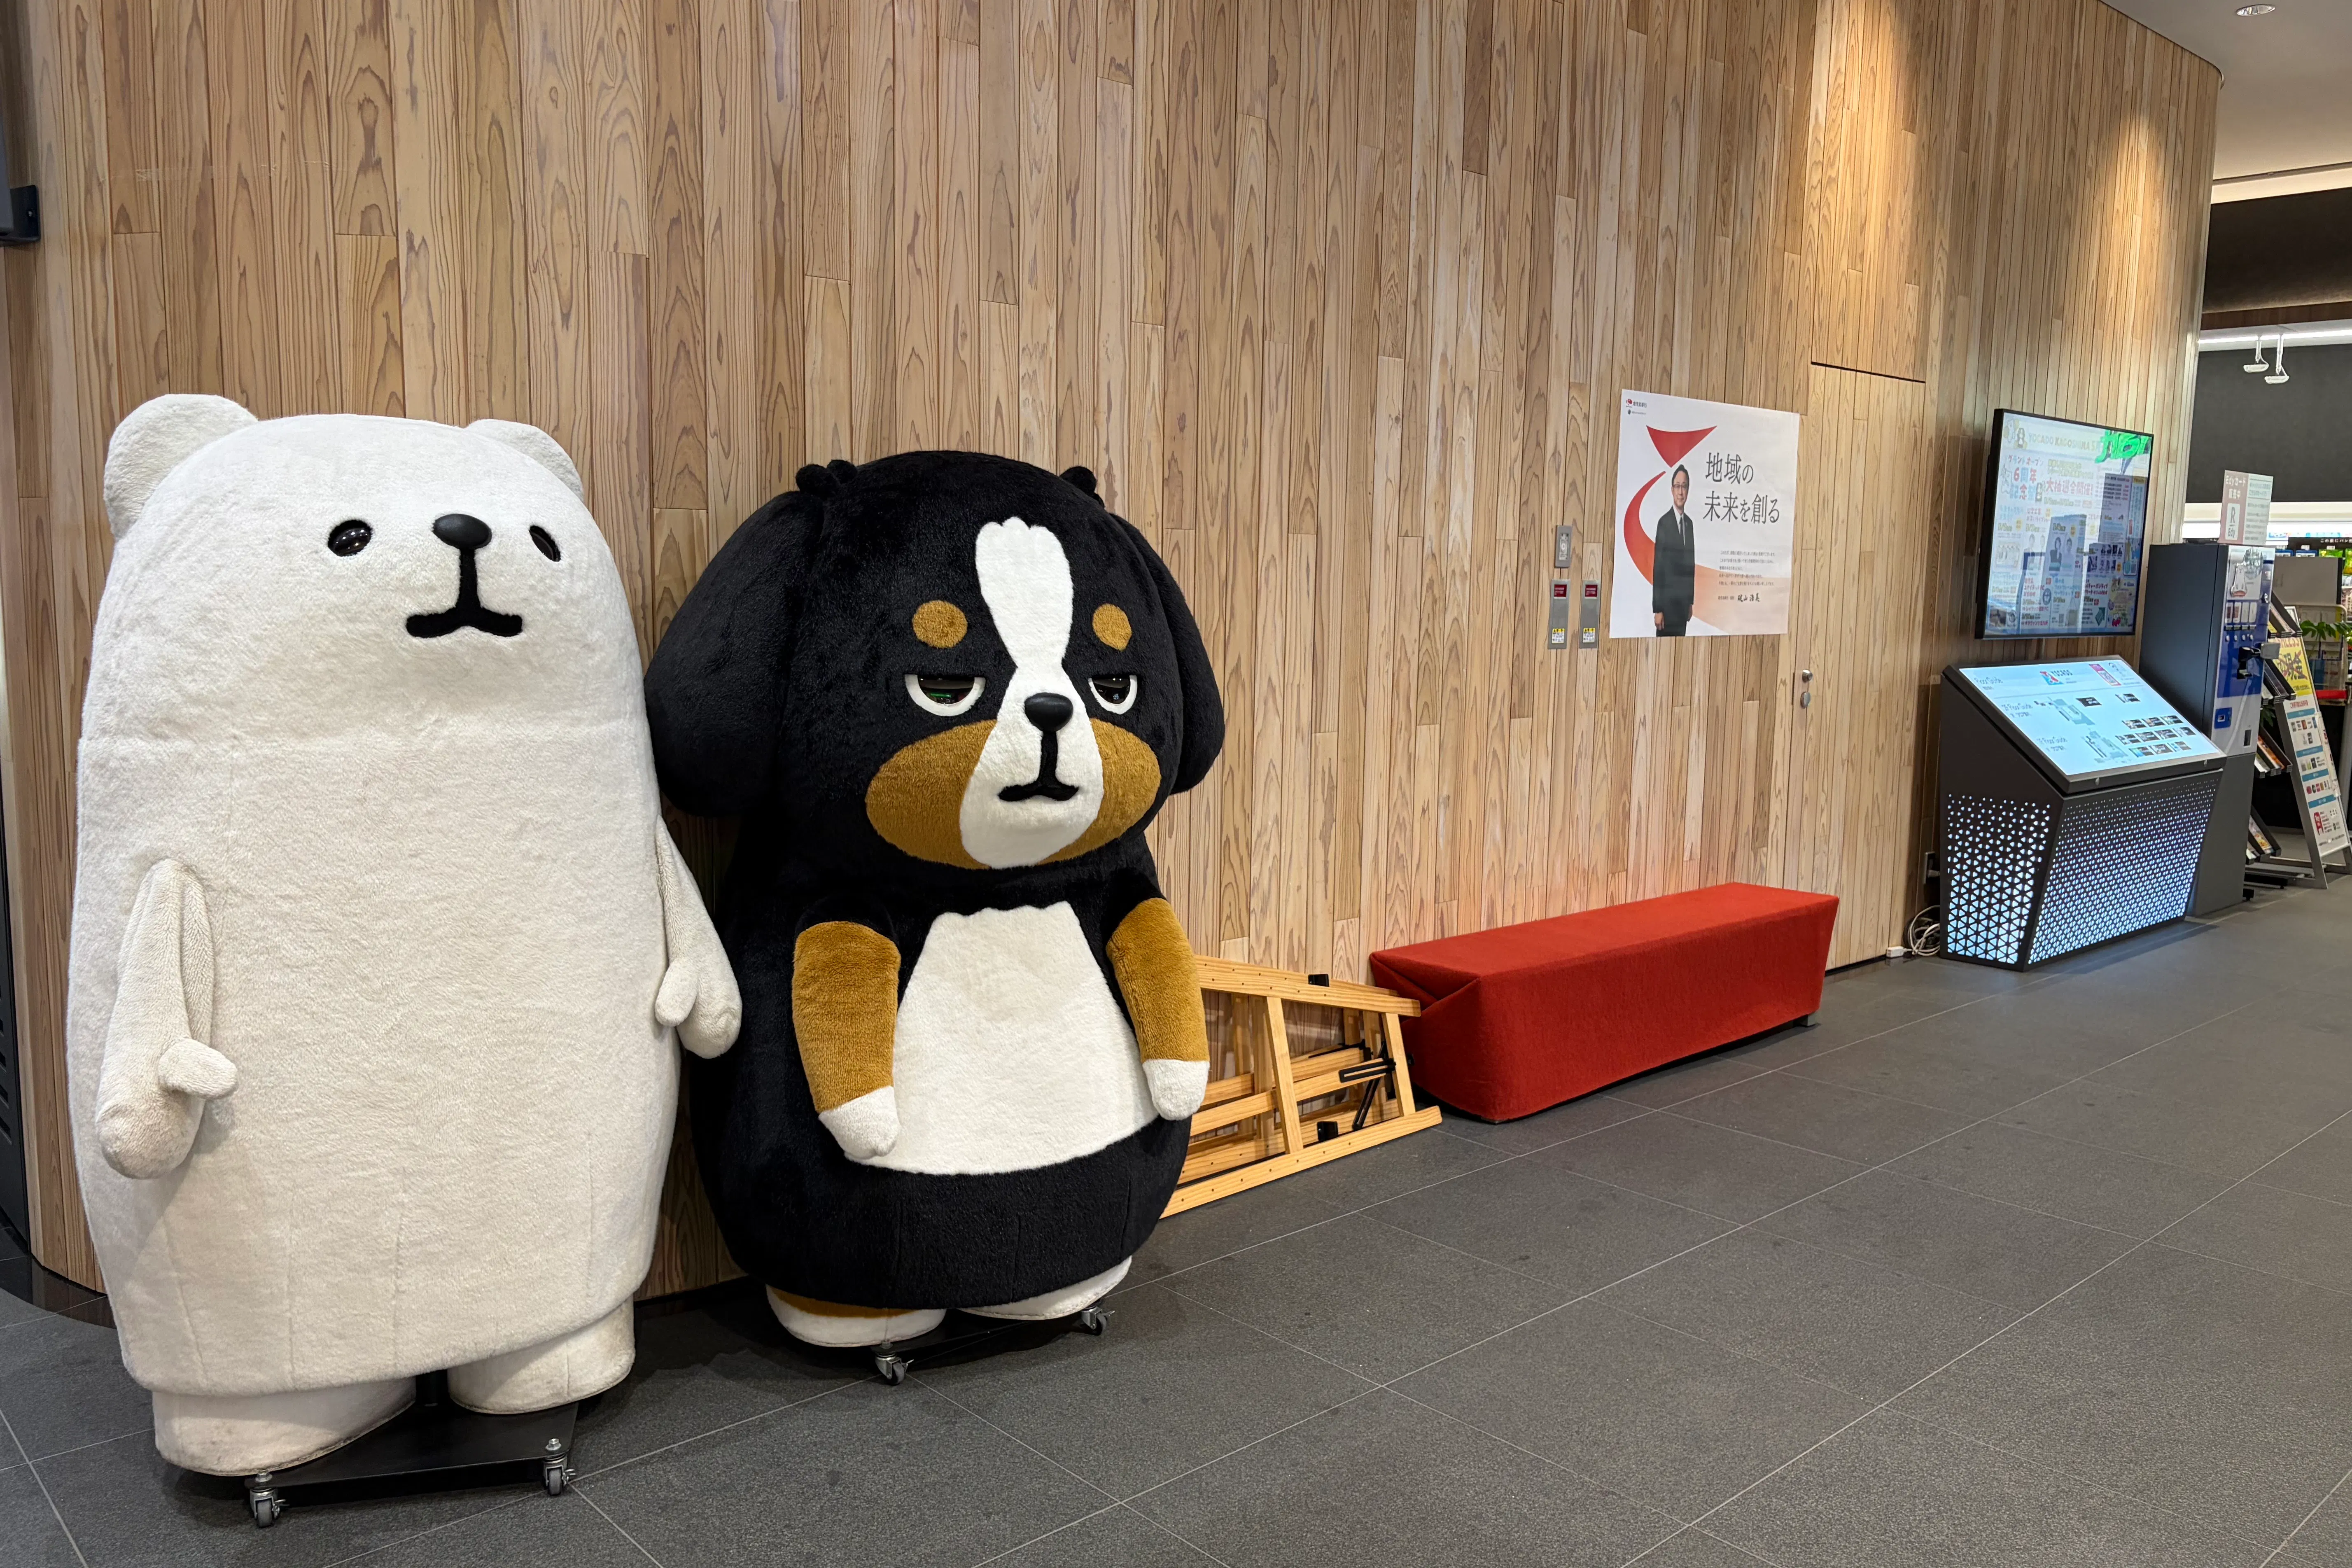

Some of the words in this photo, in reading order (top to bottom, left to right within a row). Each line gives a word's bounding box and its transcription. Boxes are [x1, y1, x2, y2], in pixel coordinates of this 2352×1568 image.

[1706, 452, 1753, 484] 地域の
[2014, 467, 2037, 484] 6周年
[1703, 490, 1779, 524] 未来を創る
[2230, 507, 2235, 523] R
